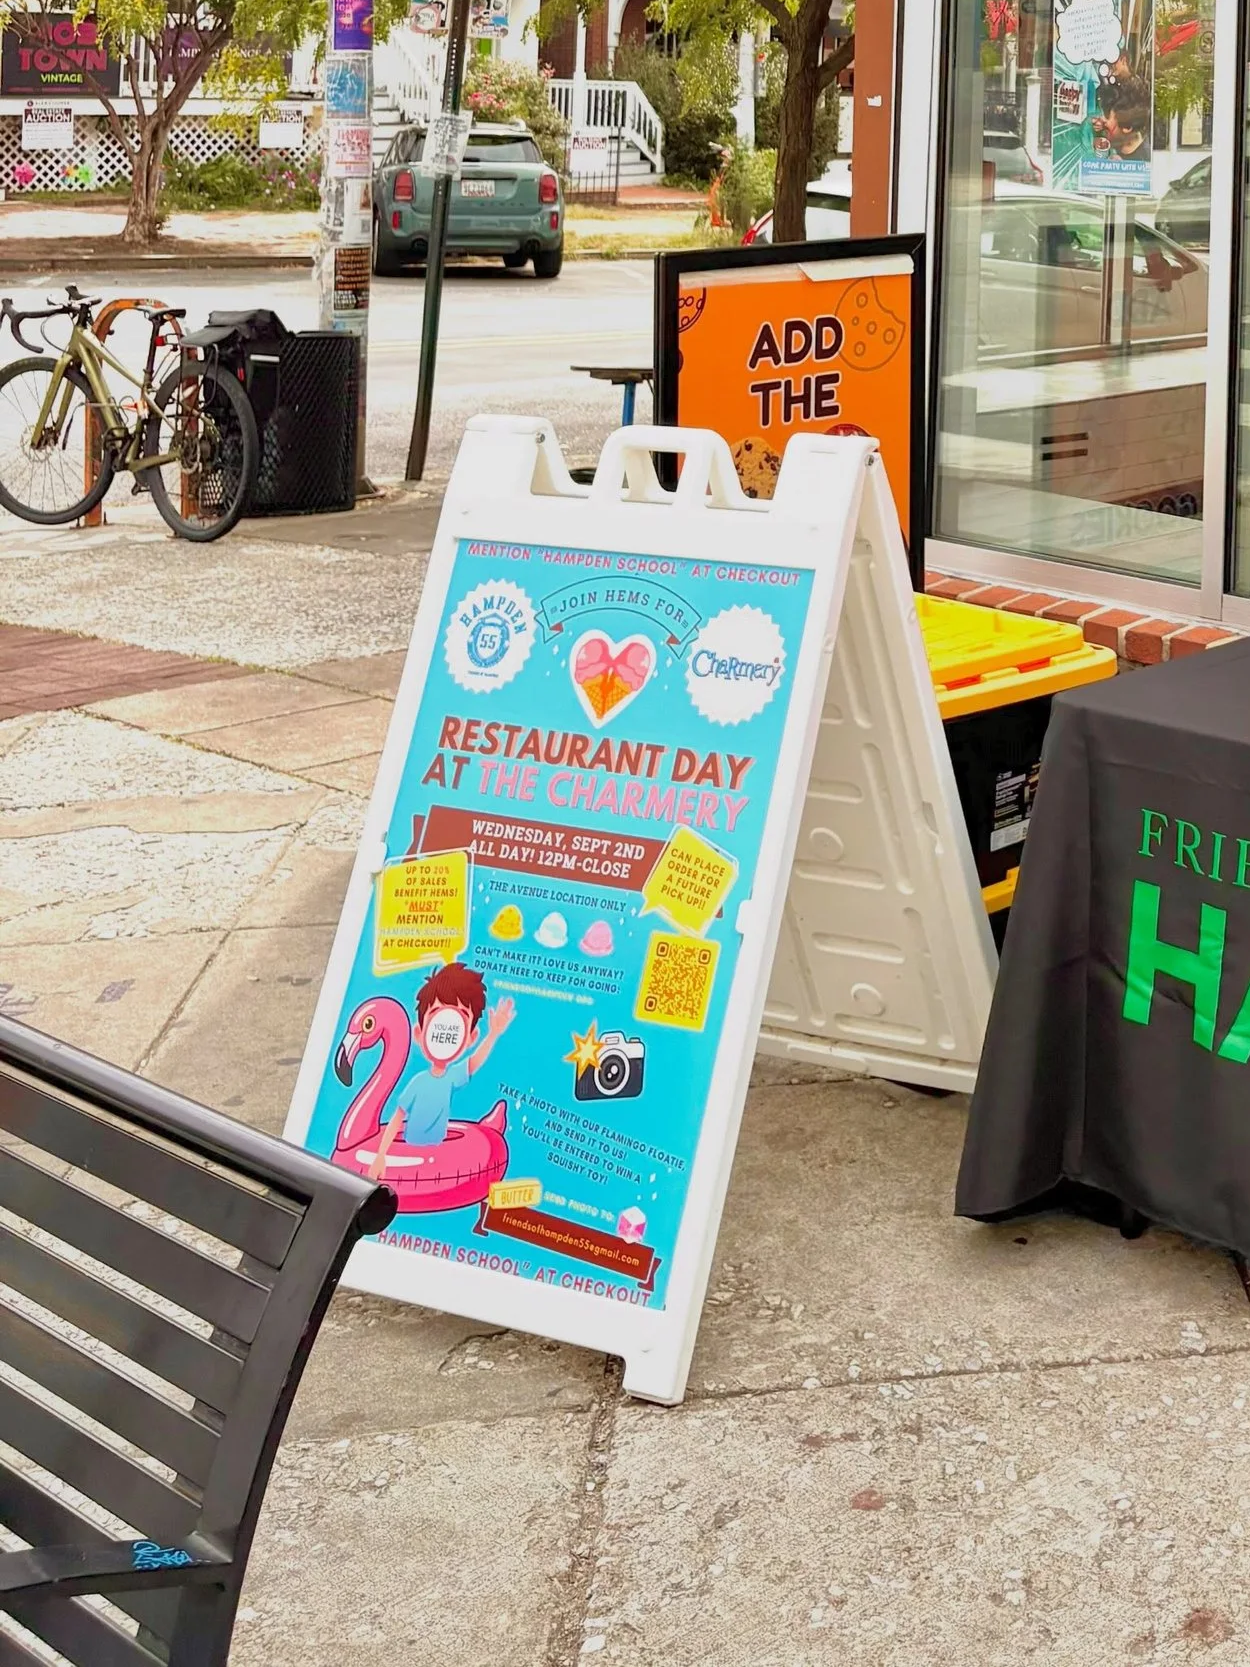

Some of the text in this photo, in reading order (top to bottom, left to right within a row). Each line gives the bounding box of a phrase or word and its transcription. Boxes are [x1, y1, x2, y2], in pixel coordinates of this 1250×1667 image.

[18, 48, 107, 72] TOWN
[40, 73, 83, 84] VINTAGE
[25, 114, 71, 123] AUCTION
[748, 315, 845, 370] ADD
[750, 372, 841, 427] THE
[467, 542, 801, 586] MENTION "HAMPDEN SCHOOL" AT CHECKOUT
[459, 595, 527, 635] HAMPDEN
[560, 589, 684, 623] JOIN HEMS FOR
[479, 633, 498, 650] 55
[438, 715, 753, 791] RESTAURANT DAY
[421, 752, 750, 833] AT THE CHARMERY
[471, 819, 646, 861] WEDNESDAY, SEPT 2ND
[420, 866, 431, 874] TO
[467, 838, 631, 879] ALL DAY! 12PM-CLOSE
[670, 848, 726, 877] CAN PLACE
[420, 877, 447, 885] SALES
[666, 874, 713, 899] A FUTURE
[667, 860, 721, 889] ORDER FOR
[394, 888, 428, 897] BENEFIT
[489, 880, 627, 912] THE AVENUE LOCATION ONLY
[660, 884, 685, 902] PICK
[396, 914, 444, 924] MENTION
[383, 938, 395, 948] AT
[474, 959, 508, 974] DONATE
[509, 965, 531, 977] HERE
[532, 968, 545, 980] TO
[546, 971, 567, 985] KEEP
[475, 946, 625, 981] CAN'T MAKE IT? LOVE US ANYWAY?
[430, 1032, 459, 1045] HERE
[499, 1083, 521, 1099] TAKE
[520, 1093, 527, 1103] A
[528, 1095, 558, 1115] PHOTO
[558, 1108, 581, 1126] WITH
[582, 1119, 601, 1133] OUR
[601, 1125, 647, 1154] FLAMINGO
[544, 1119, 563, 1134] AND
[563, 1127, 586, 1144] SEND
[587, 1136, 597, 1148] IT
[598, 1140, 611, 1155] TO
[521, 1122, 642, 1185] YOU'LL BE ENTERED TO WIN A
[547, 1151, 586, 1176] SQUISHY
[500, 1188, 535, 1206] BUTTER
[377, 1229, 651, 1308] HAMPDEN SCHOOL" AT CHECKOUT
